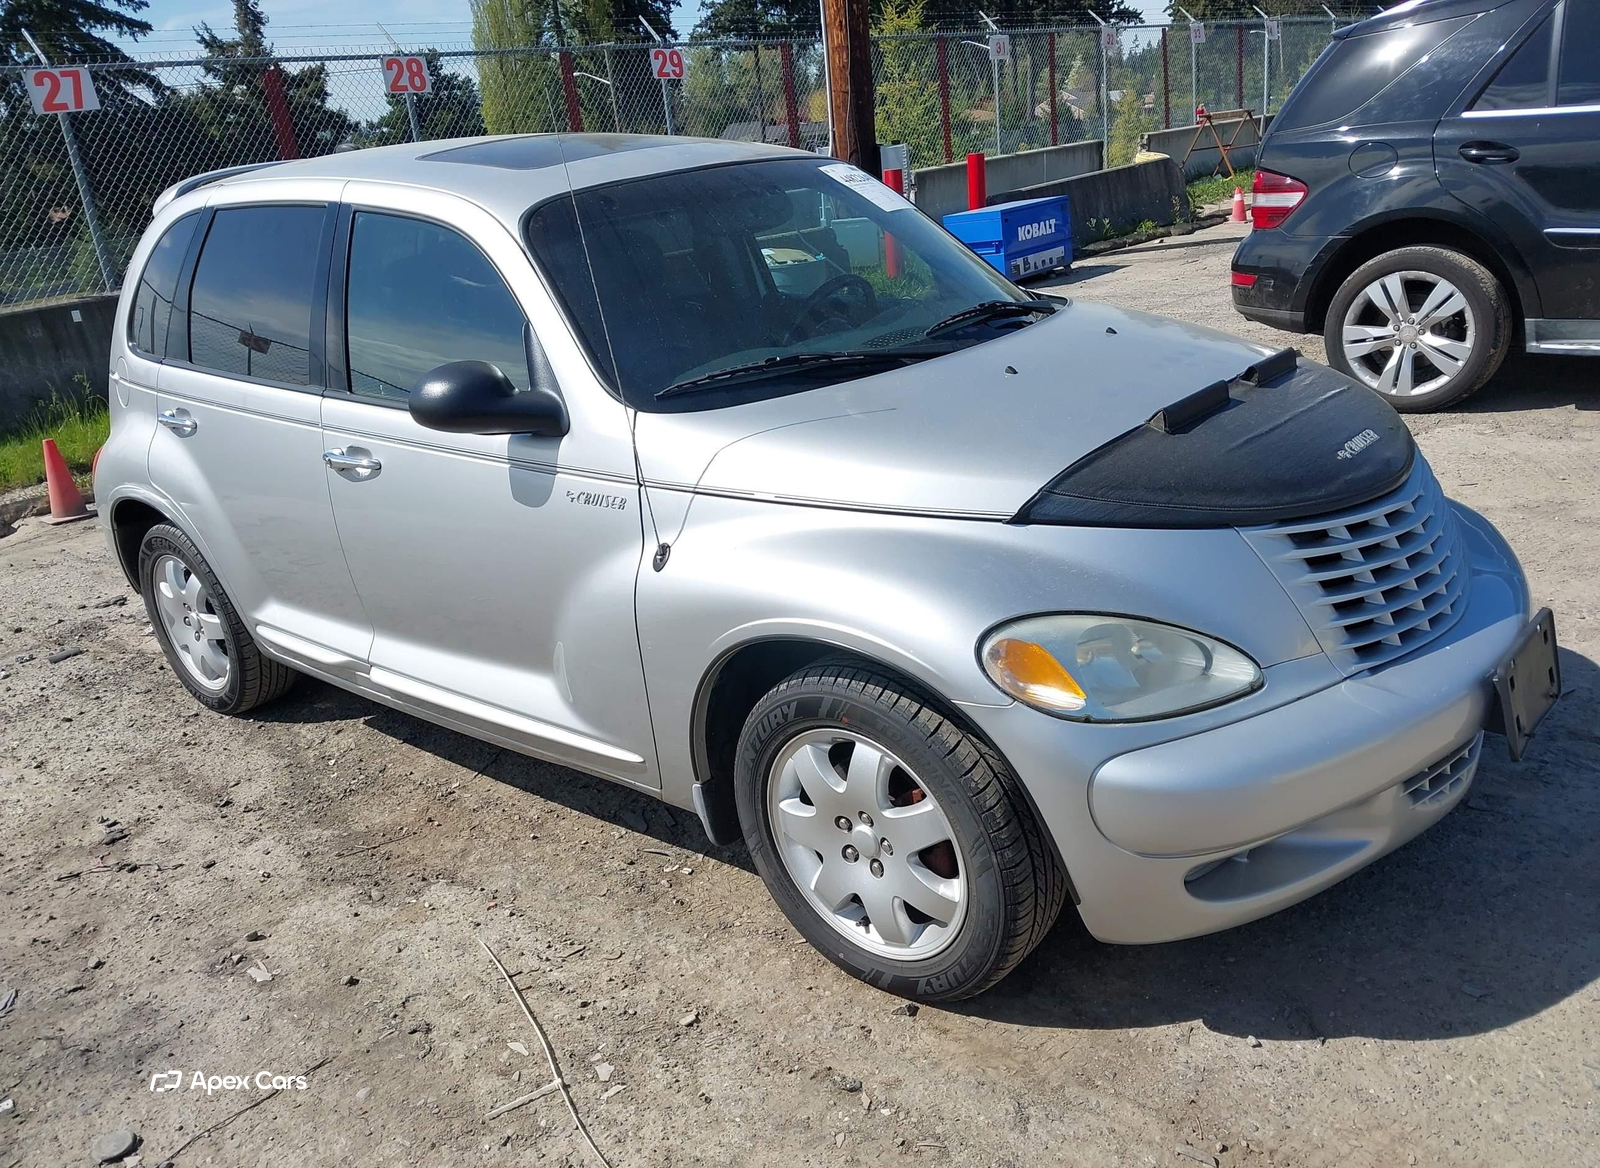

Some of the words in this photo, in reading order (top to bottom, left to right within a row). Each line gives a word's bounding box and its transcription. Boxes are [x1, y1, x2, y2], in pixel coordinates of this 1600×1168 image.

[996, 41, 1006, 54] 31
[385, 57, 427, 92] 28
[653, 50, 684, 78] 29
[33, 69, 84, 112] 27
[1017, 218, 1056, 241] KOBALT
[1344, 428, 1381, 455] CRUISER
[576, 491, 628, 511] CRUISER
